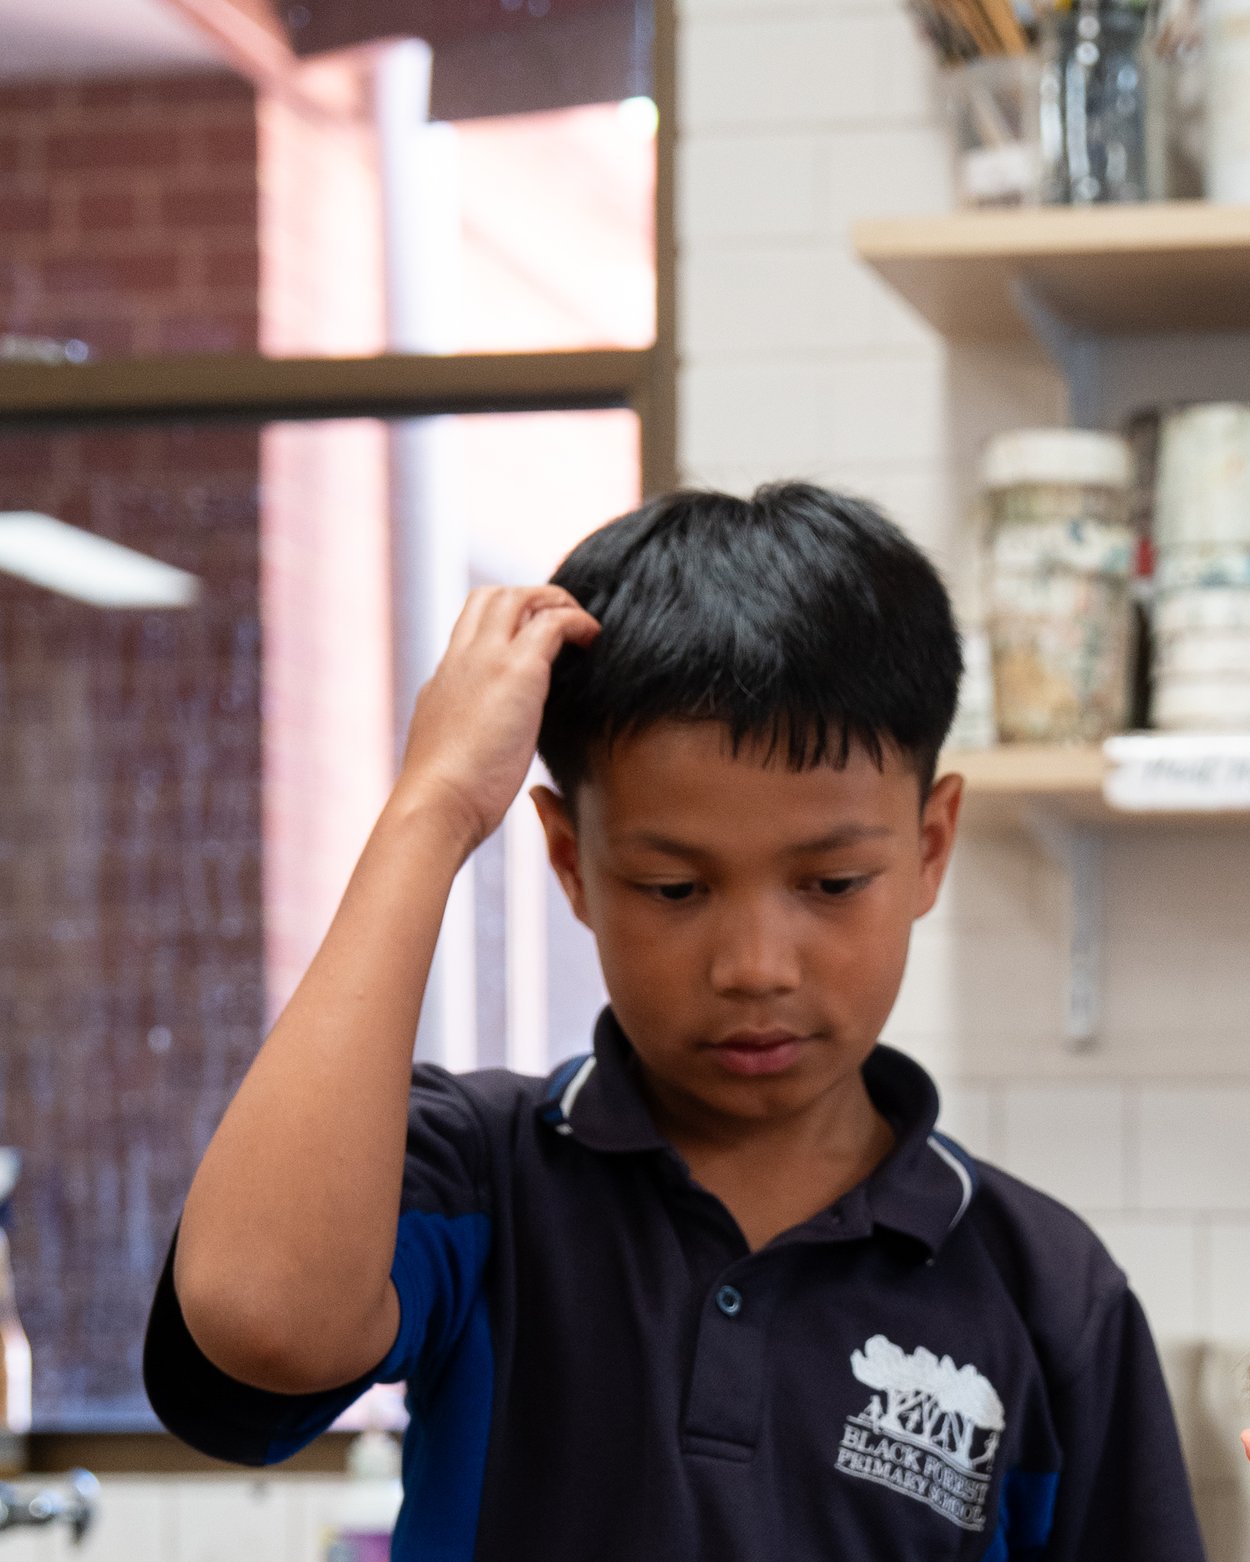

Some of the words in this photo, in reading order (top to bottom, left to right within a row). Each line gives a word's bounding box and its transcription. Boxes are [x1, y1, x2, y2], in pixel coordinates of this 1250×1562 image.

[836, 1449, 931, 1496] PRIMARY
[843, 1424, 921, 1473] BLACK
[923, 1455, 990, 1505] FOREST
